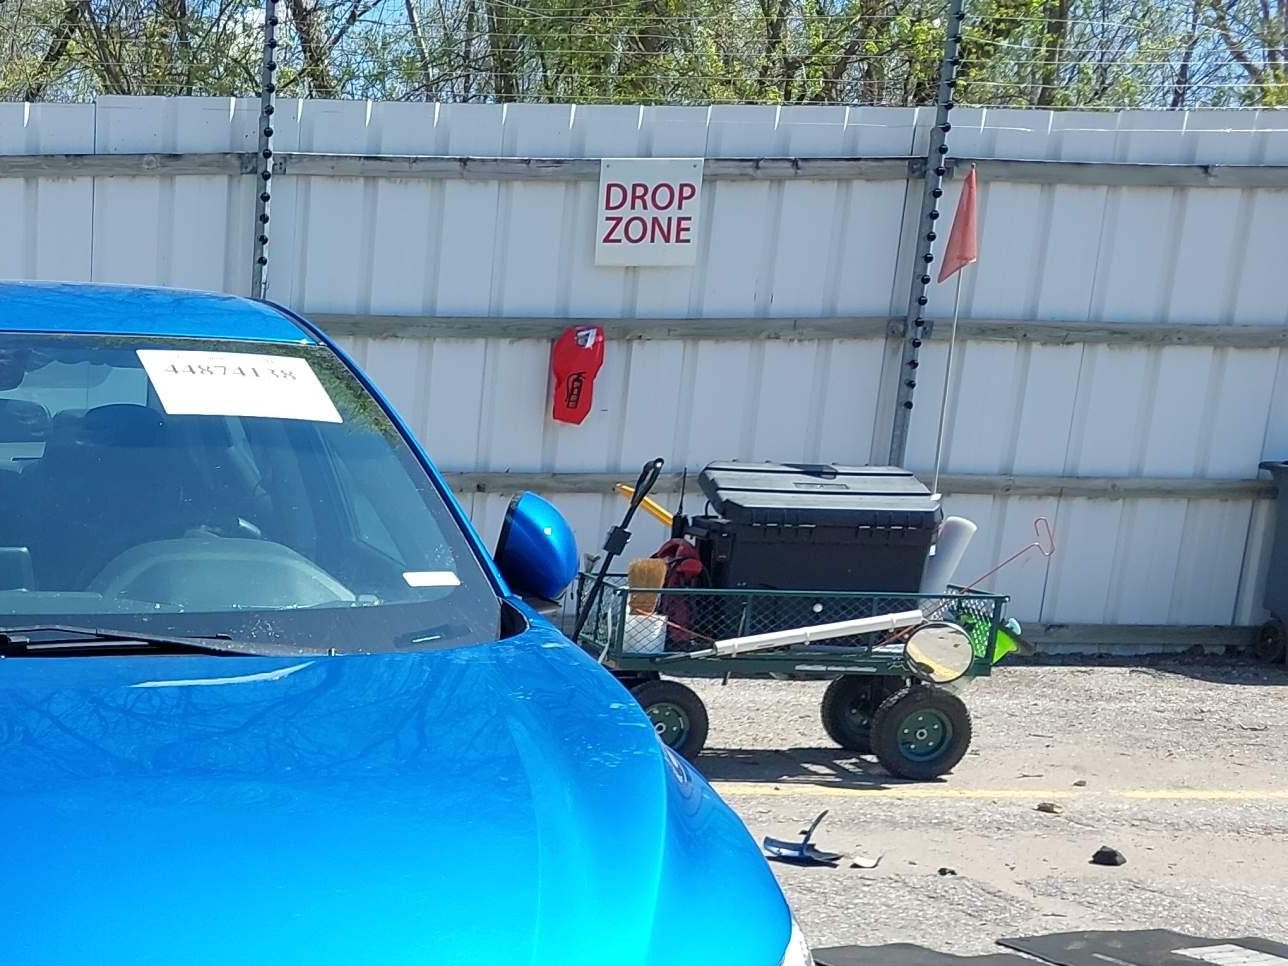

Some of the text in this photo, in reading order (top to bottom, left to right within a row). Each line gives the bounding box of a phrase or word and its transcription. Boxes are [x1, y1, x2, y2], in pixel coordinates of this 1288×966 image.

[605, 183, 696, 210] DROP
[602, 216, 692, 243] ZONE
[164, 363, 297, 380] 44874138
